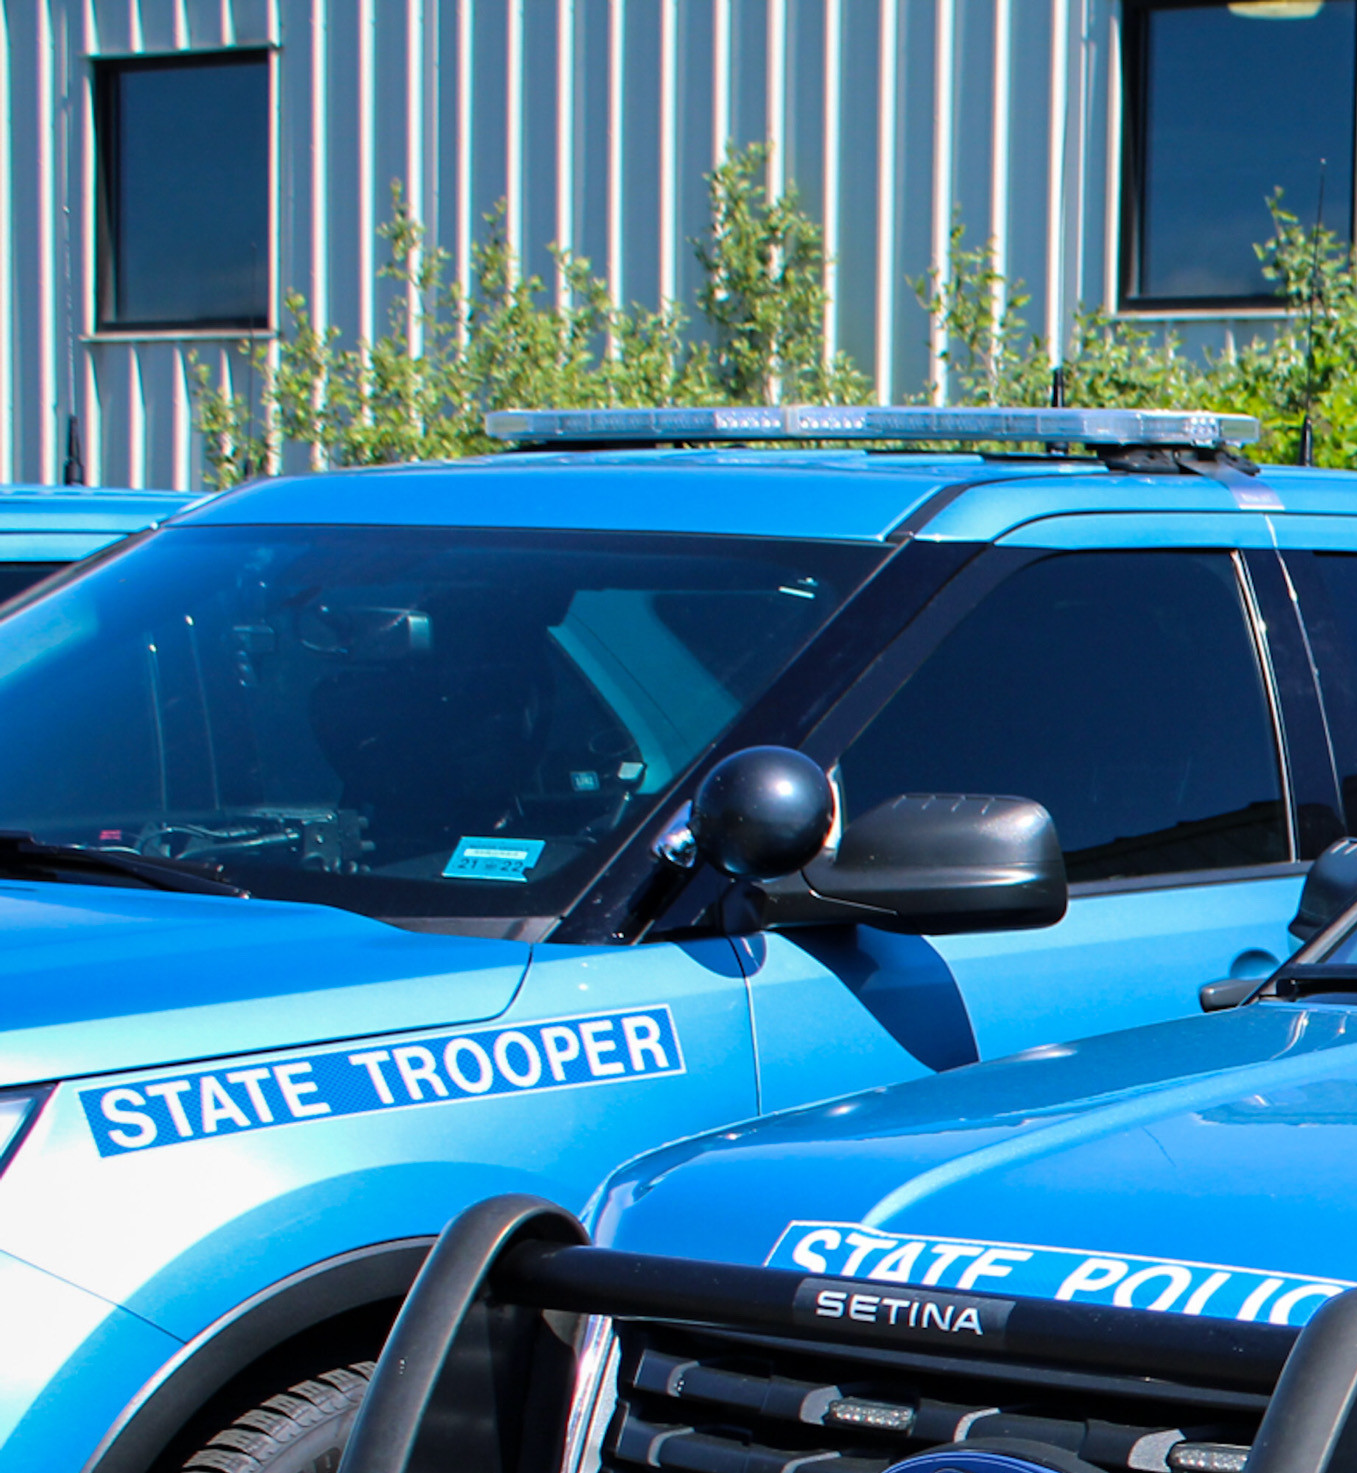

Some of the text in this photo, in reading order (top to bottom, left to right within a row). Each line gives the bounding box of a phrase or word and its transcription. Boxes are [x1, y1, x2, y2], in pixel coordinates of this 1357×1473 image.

[101, 1016, 668, 1147] STATE TROOPER
[815, 1290, 983, 1336] SETINA
